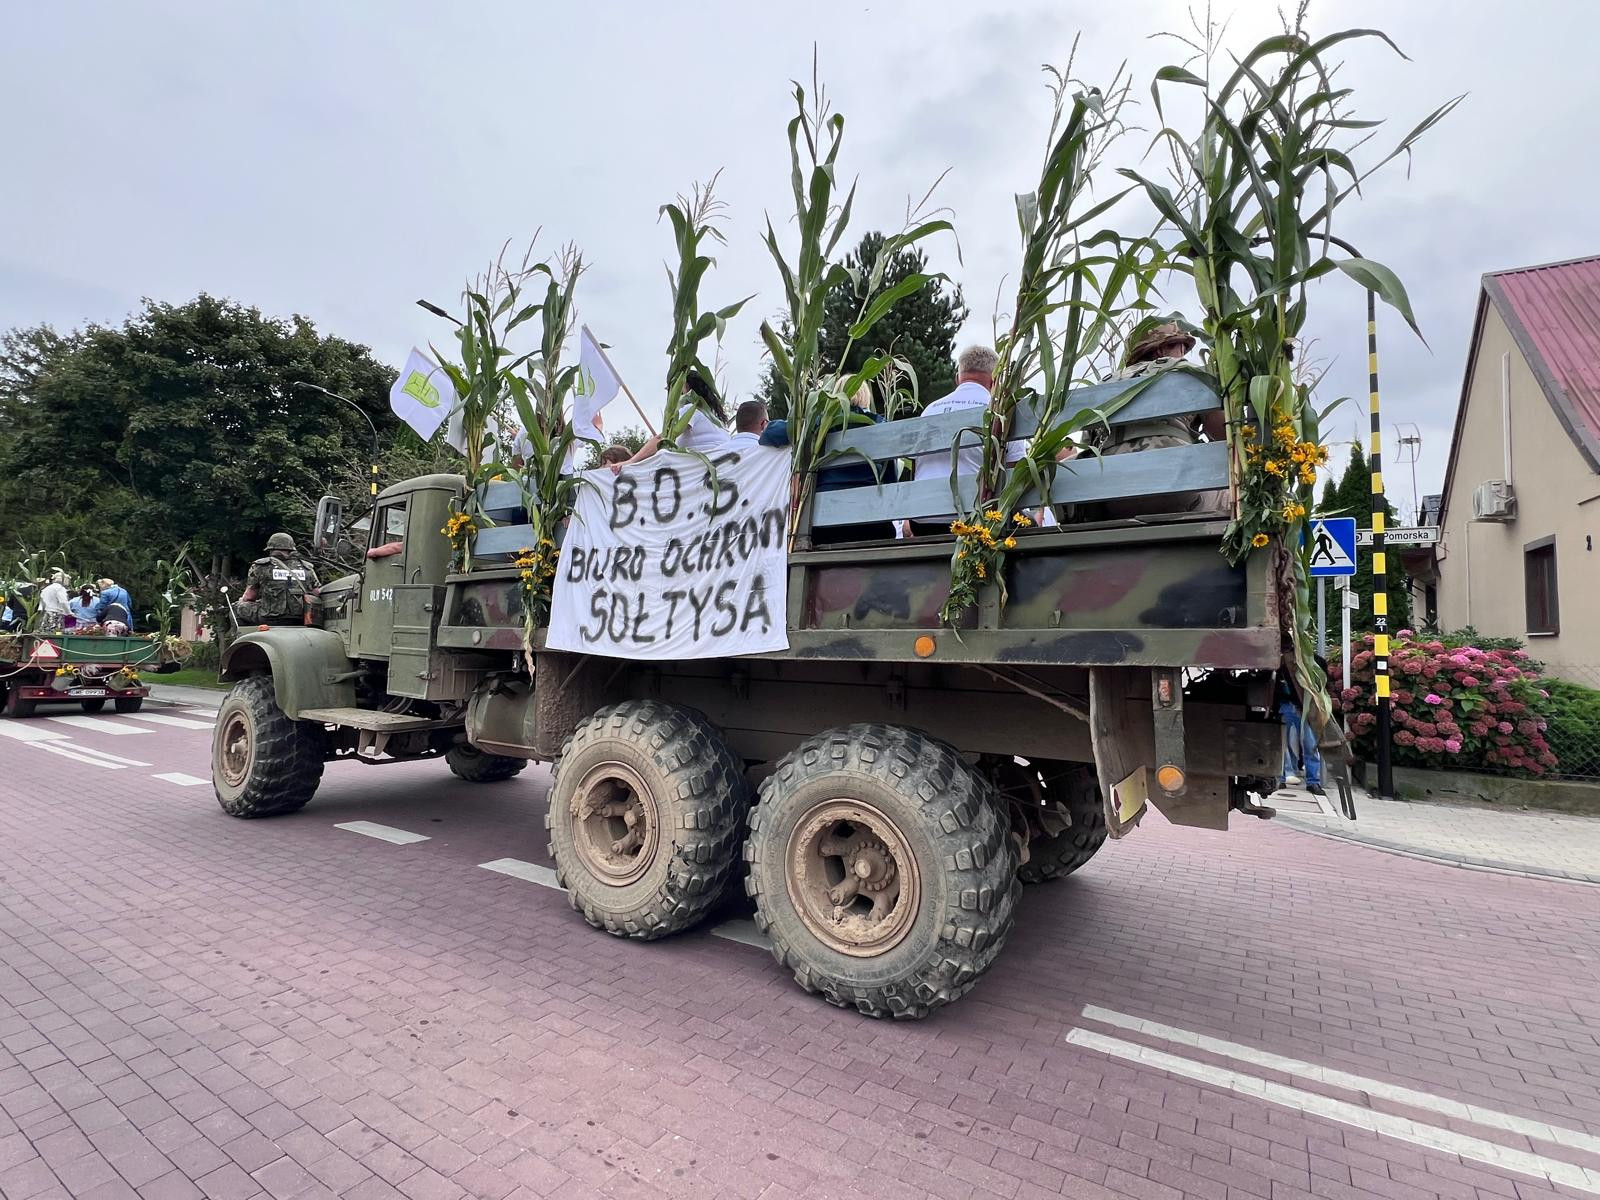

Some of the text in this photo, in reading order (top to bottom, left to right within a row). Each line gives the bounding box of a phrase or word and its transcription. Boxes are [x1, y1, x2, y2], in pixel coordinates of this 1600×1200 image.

[611, 452, 749, 530] B.O.S.
[1384, 530, 1429, 541] Pomorska
[567, 545, 647, 583] BIURO
